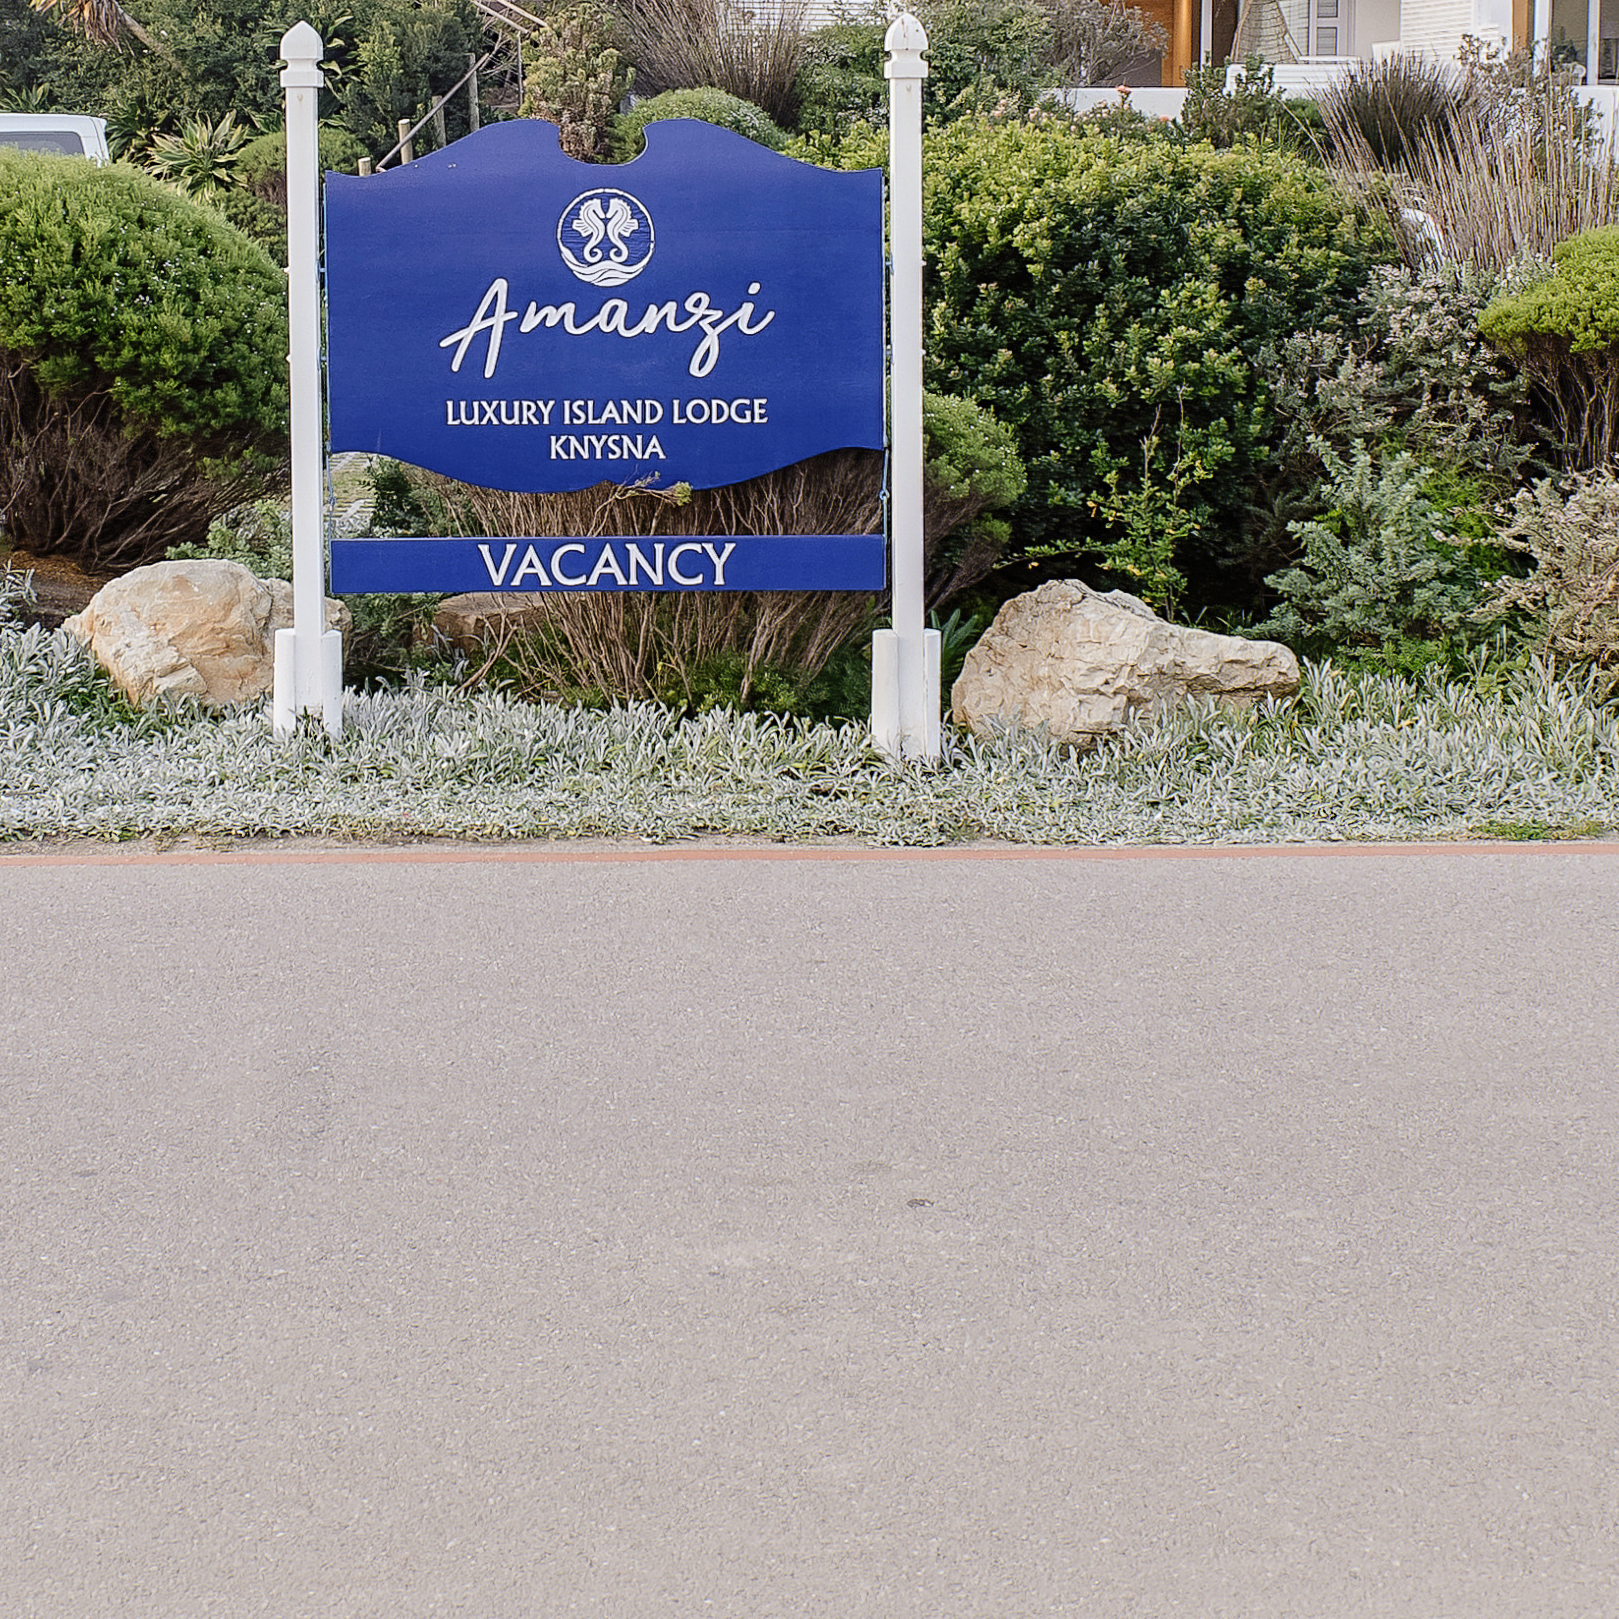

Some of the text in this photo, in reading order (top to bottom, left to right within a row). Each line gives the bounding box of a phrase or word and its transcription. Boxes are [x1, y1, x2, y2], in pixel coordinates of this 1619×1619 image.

[440, 278, 775, 379] Amanzi
[446, 399, 769, 426] LUXURY ISLAND LODGE
[550, 435, 667, 460] KNYSNA
[478, 542, 737, 587] VACANCY
